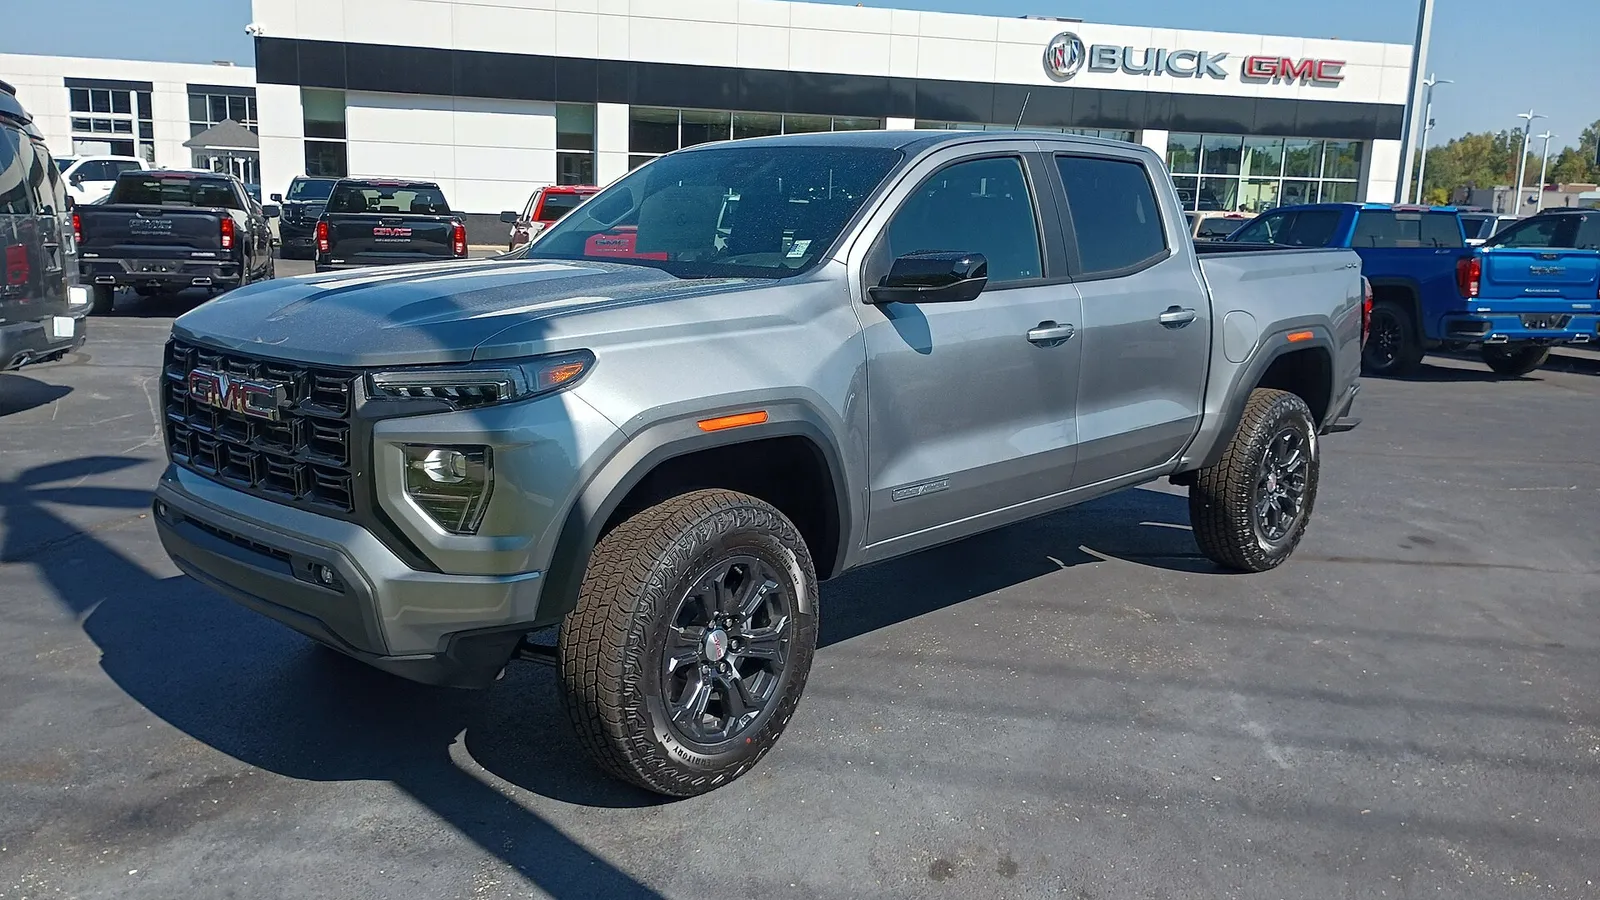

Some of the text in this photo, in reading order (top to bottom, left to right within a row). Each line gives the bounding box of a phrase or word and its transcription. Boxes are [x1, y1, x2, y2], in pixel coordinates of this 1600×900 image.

[1088, 44, 1230, 80] BUICK
[1243, 54, 1347, 85] GMC
[373, 227, 412, 236] GMC
[189, 368, 280, 421] GMC
